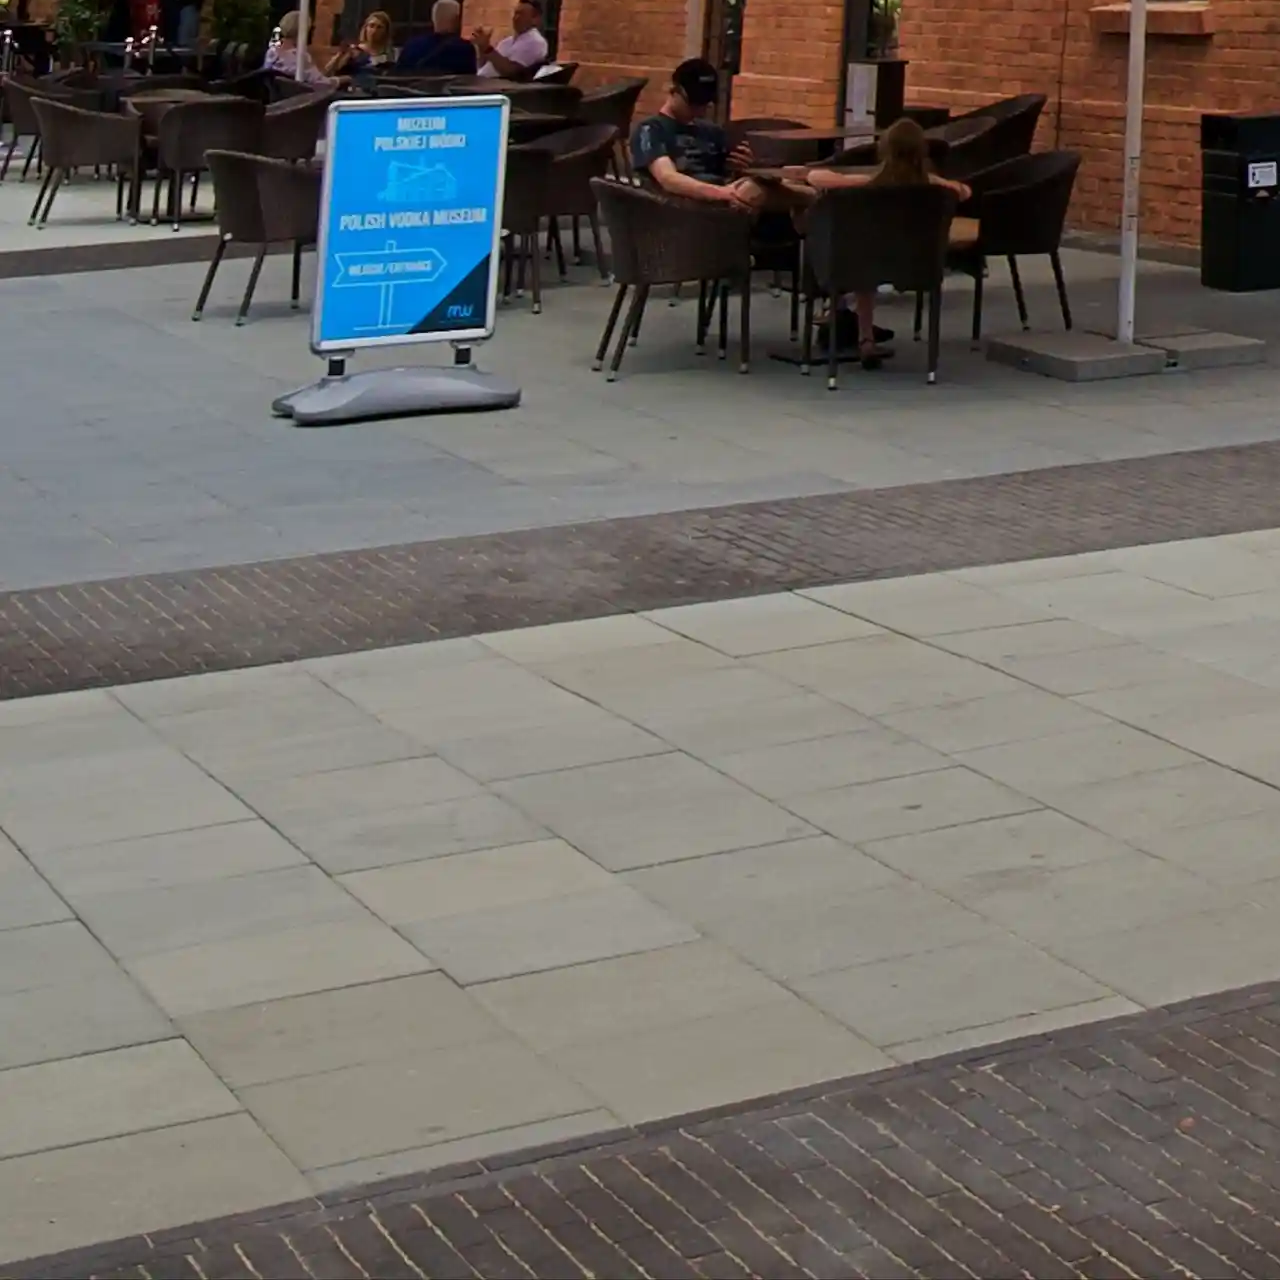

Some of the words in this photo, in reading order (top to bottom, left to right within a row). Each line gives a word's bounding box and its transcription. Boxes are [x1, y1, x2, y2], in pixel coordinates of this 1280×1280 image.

[340, 213, 386, 231] POLISH
[389, 211, 431, 228] VODKA
[433, 208, 487, 225] MUSEUM
